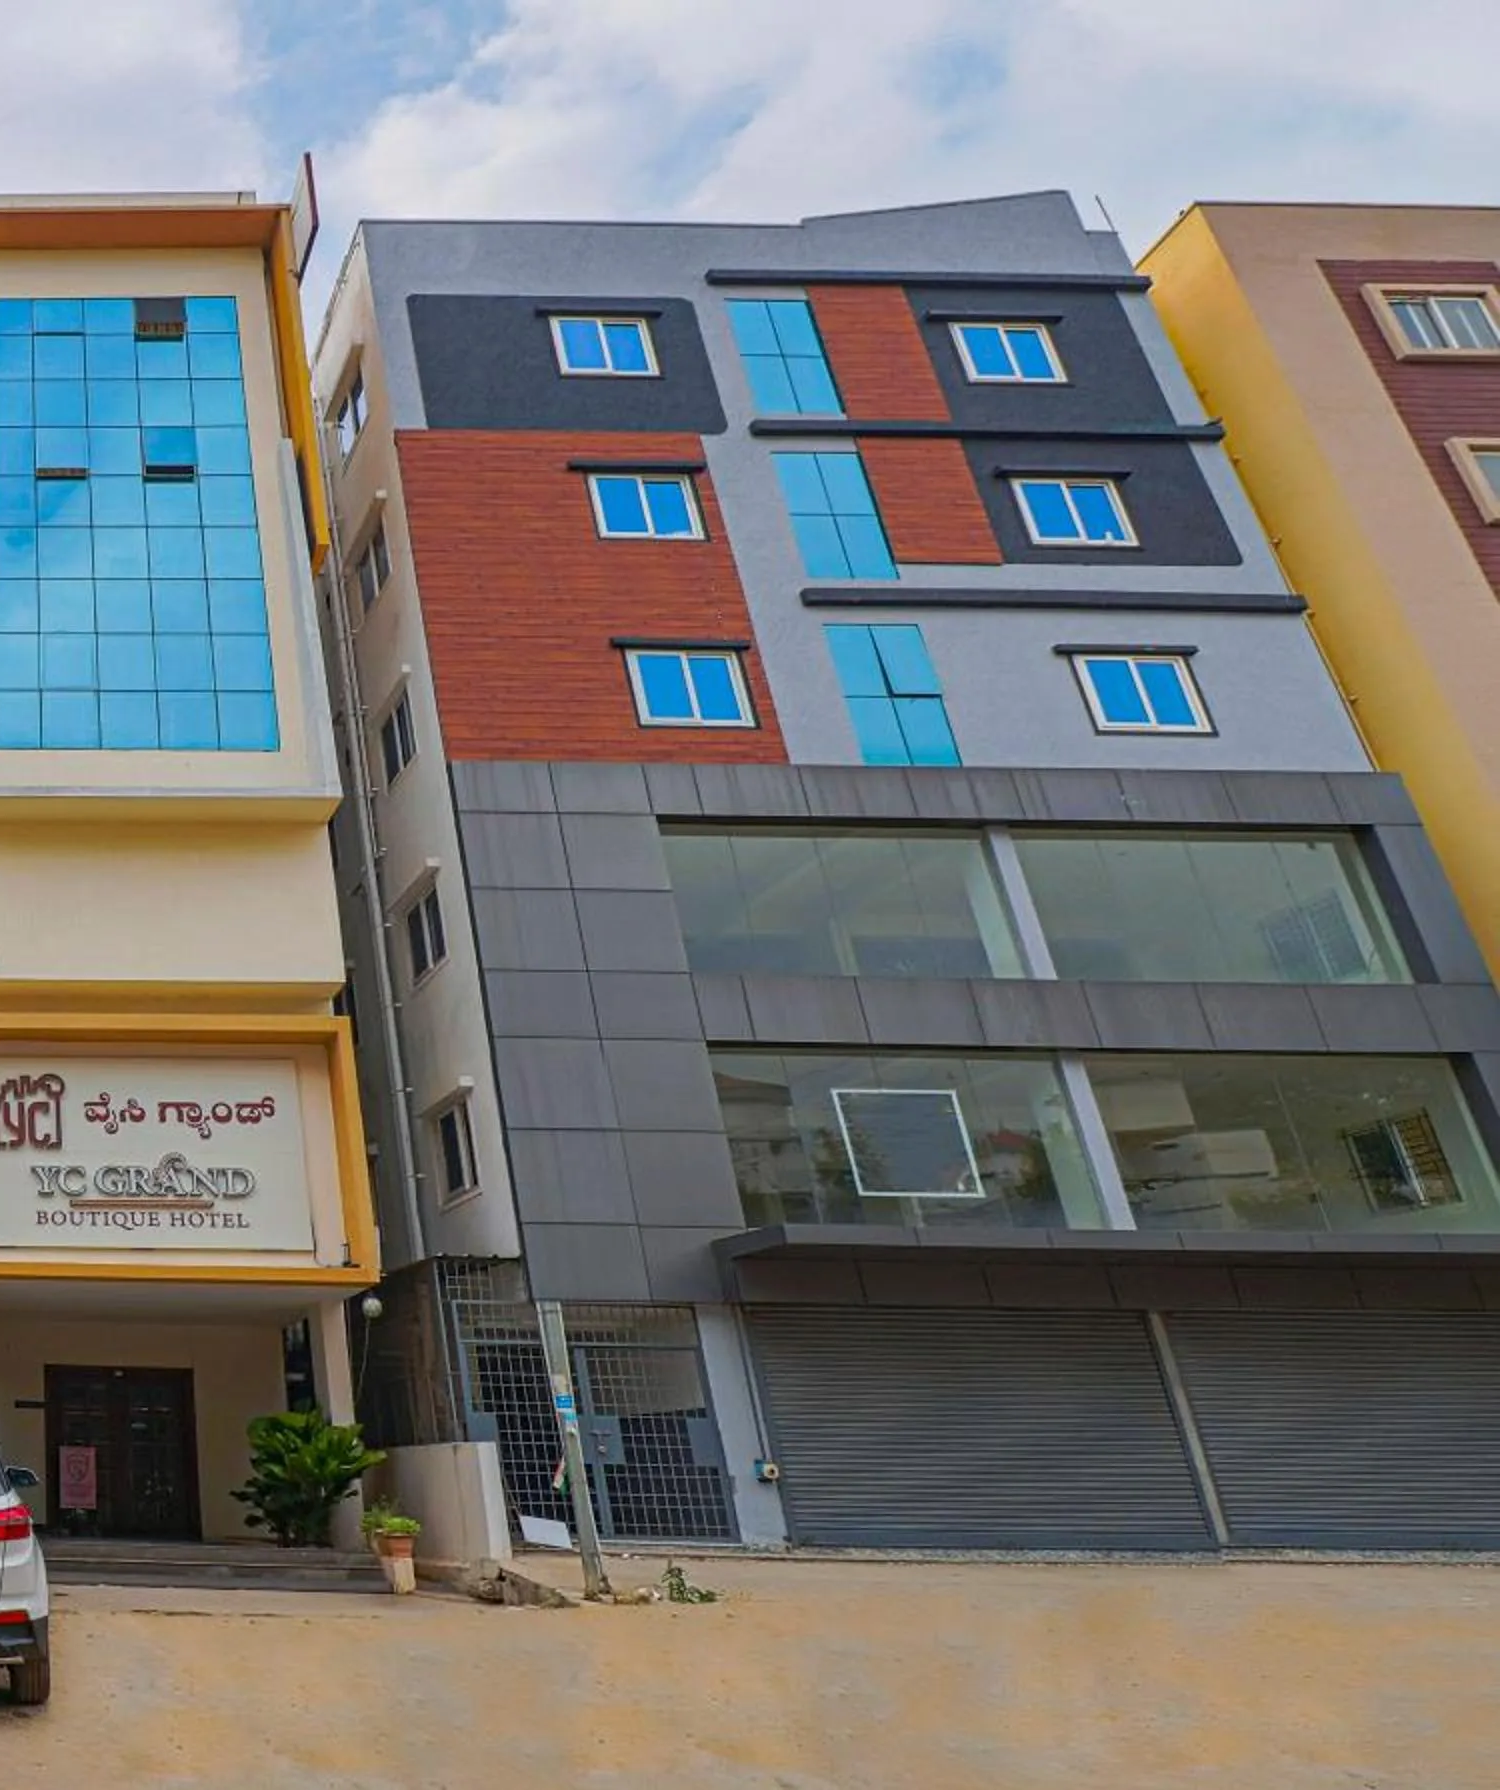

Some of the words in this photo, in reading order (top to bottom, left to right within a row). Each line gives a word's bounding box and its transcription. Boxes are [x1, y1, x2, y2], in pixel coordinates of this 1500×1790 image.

[84, 1092, 146, 1134] ವೈಸಿ
[31, 1165, 88, 1196] YC
[93, 1163, 256, 1200] GRAND
[36, 1211, 161, 1230] BOUTIQUE
[169, 1212, 250, 1229] HOTEL
